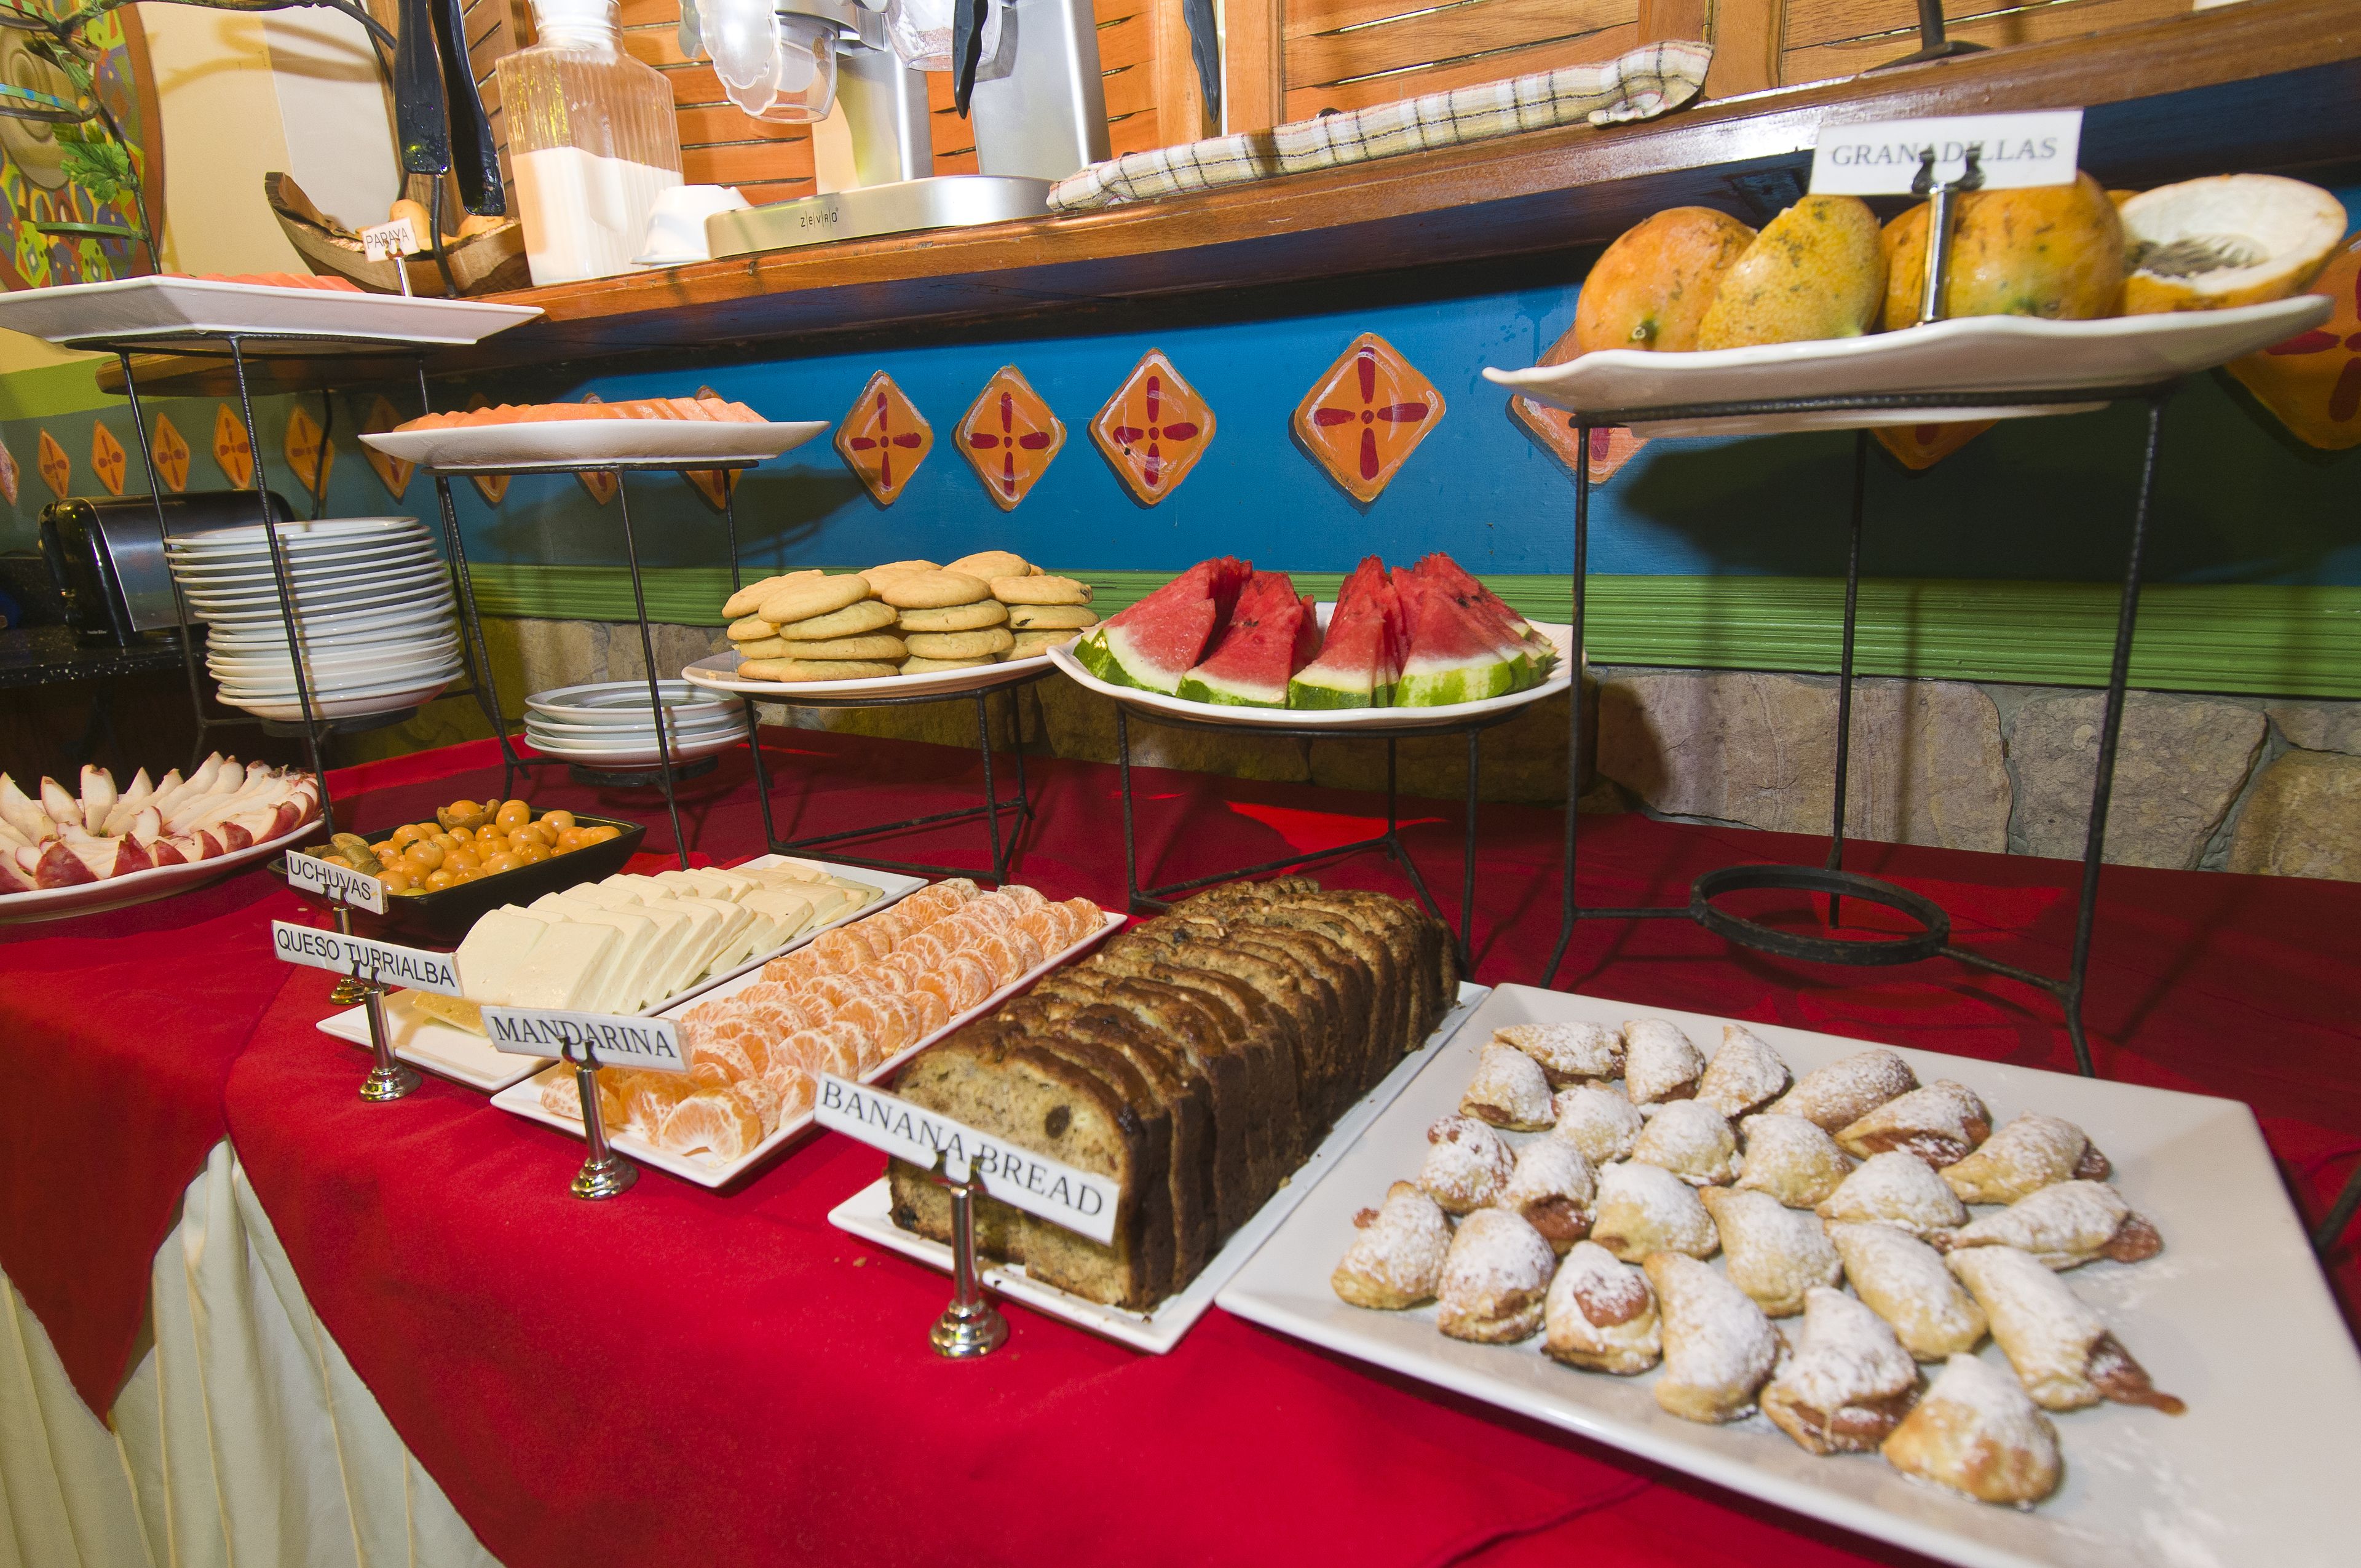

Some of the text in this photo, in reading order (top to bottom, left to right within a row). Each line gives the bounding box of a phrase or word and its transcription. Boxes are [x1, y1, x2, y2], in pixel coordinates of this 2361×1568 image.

[290, 857, 371, 900] UCHUVAS
[277, 928, 455, 988] QUESO TURRIALBA
[491, 1016, 677, 1058] MANDARINA
[821, 1080, 1103, 1216] BANANA BREAD
